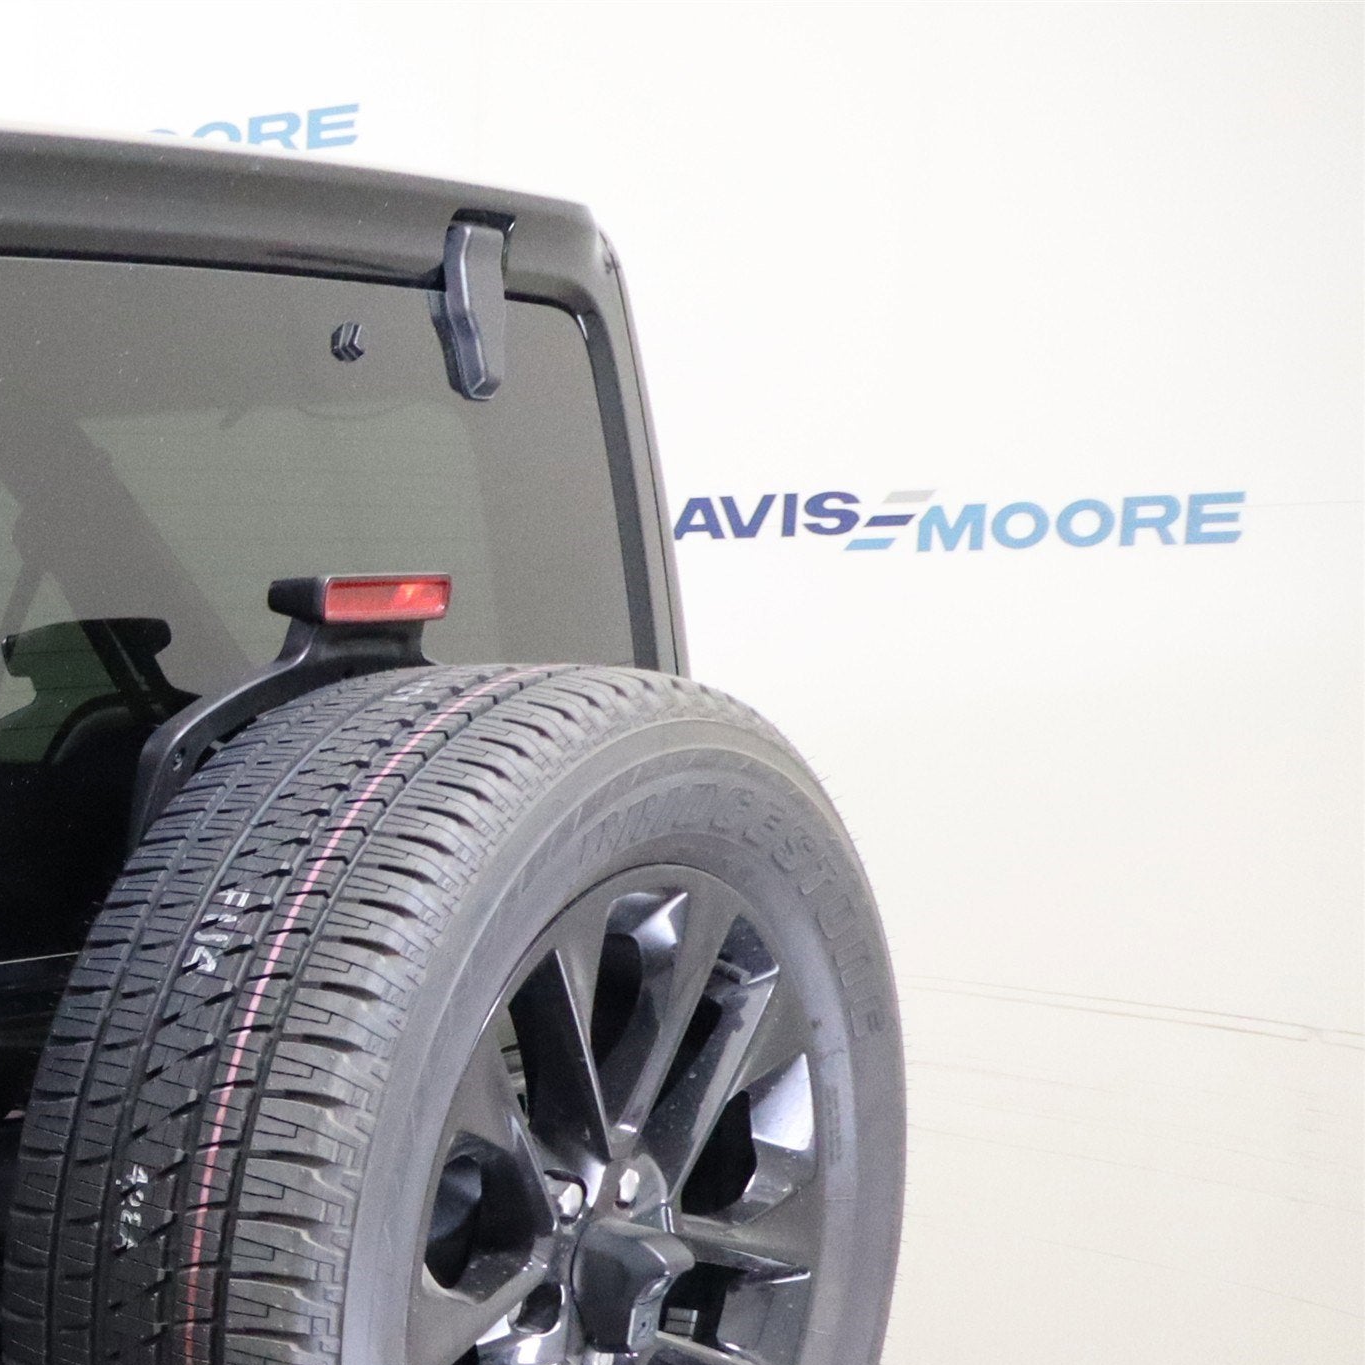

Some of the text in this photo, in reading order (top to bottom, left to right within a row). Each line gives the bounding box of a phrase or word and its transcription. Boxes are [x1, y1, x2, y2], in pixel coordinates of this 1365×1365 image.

[147, 102, 360, 151] ORE
[673, 490, 1247, 553] AVIS MOORE
